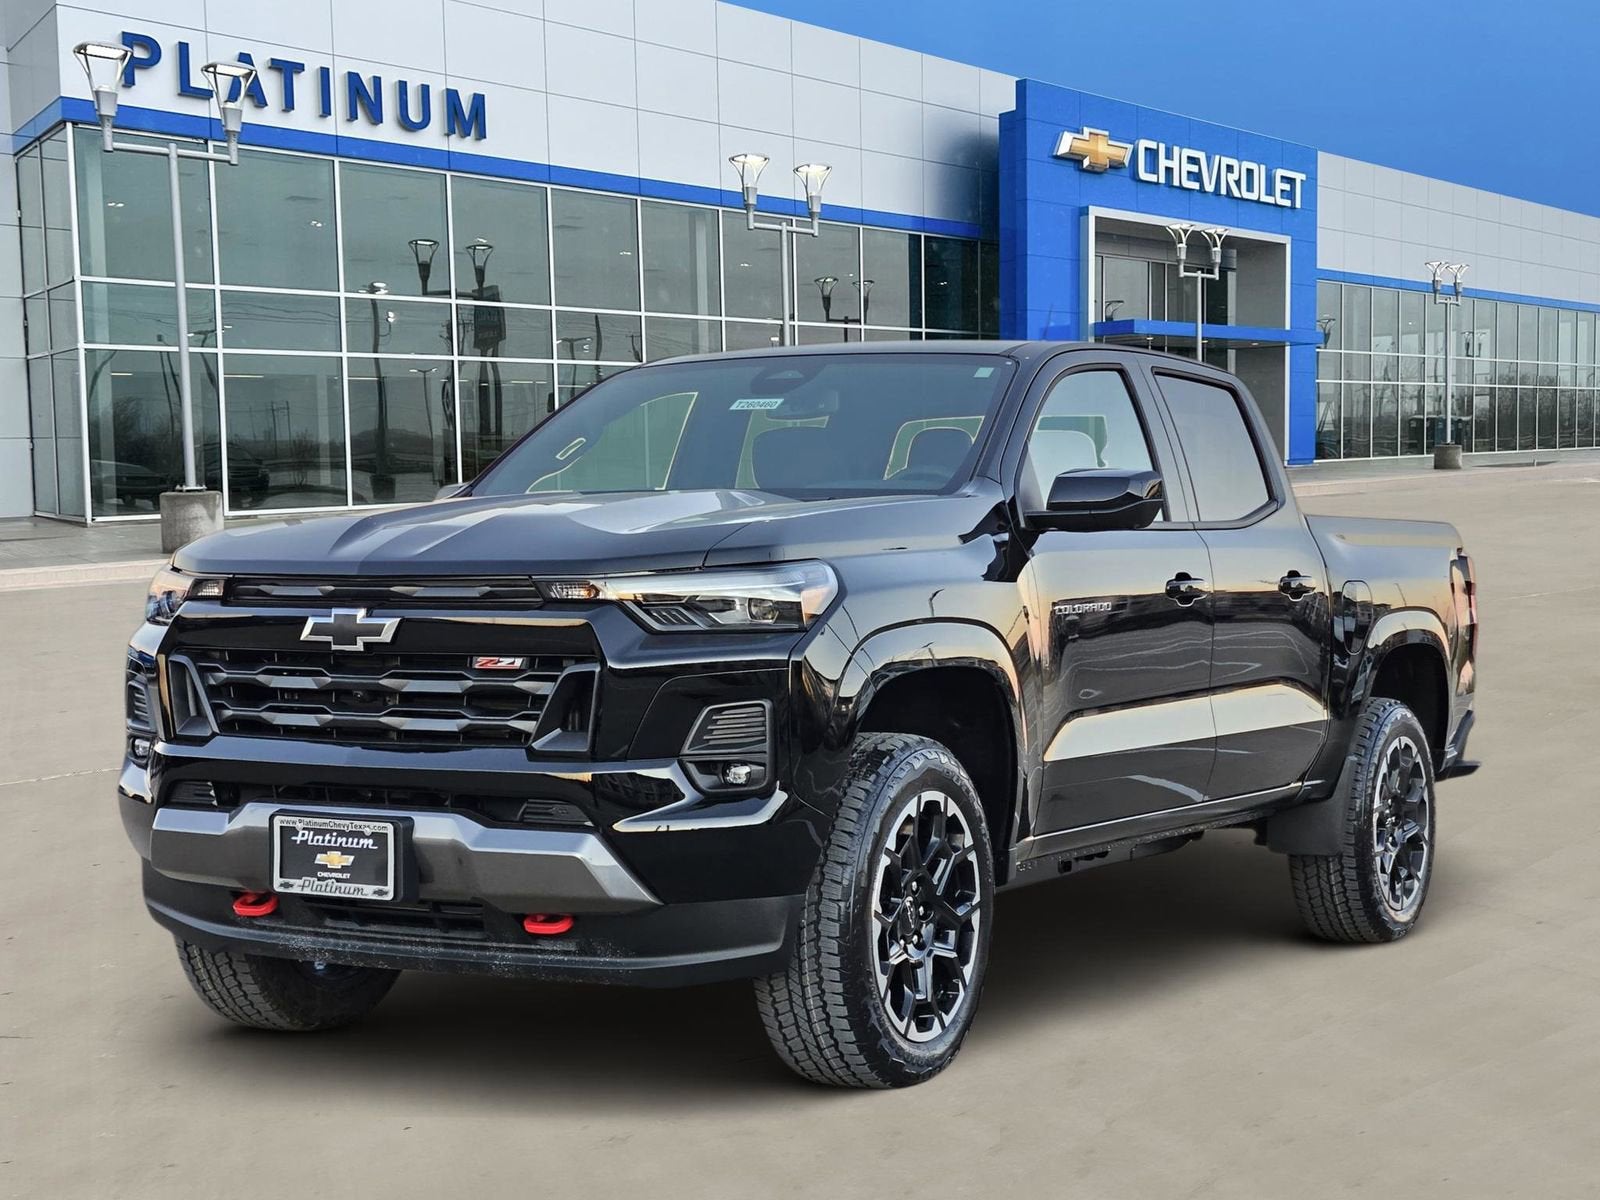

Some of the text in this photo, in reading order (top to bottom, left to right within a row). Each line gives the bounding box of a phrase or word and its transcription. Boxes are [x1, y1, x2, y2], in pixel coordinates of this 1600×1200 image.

[121, 31, 487, 141] PLATINUM
[1136, 138, 1307, 209] CHEVROLET
[1053, 602, 1112, 615] COLORADO
[474, 656, 524, 670] Z71
[291, 830, 379, 850] Platinum
[316, 871, 351, 879] CHEVROLET
[297, 879, 369, 897] Platinum
